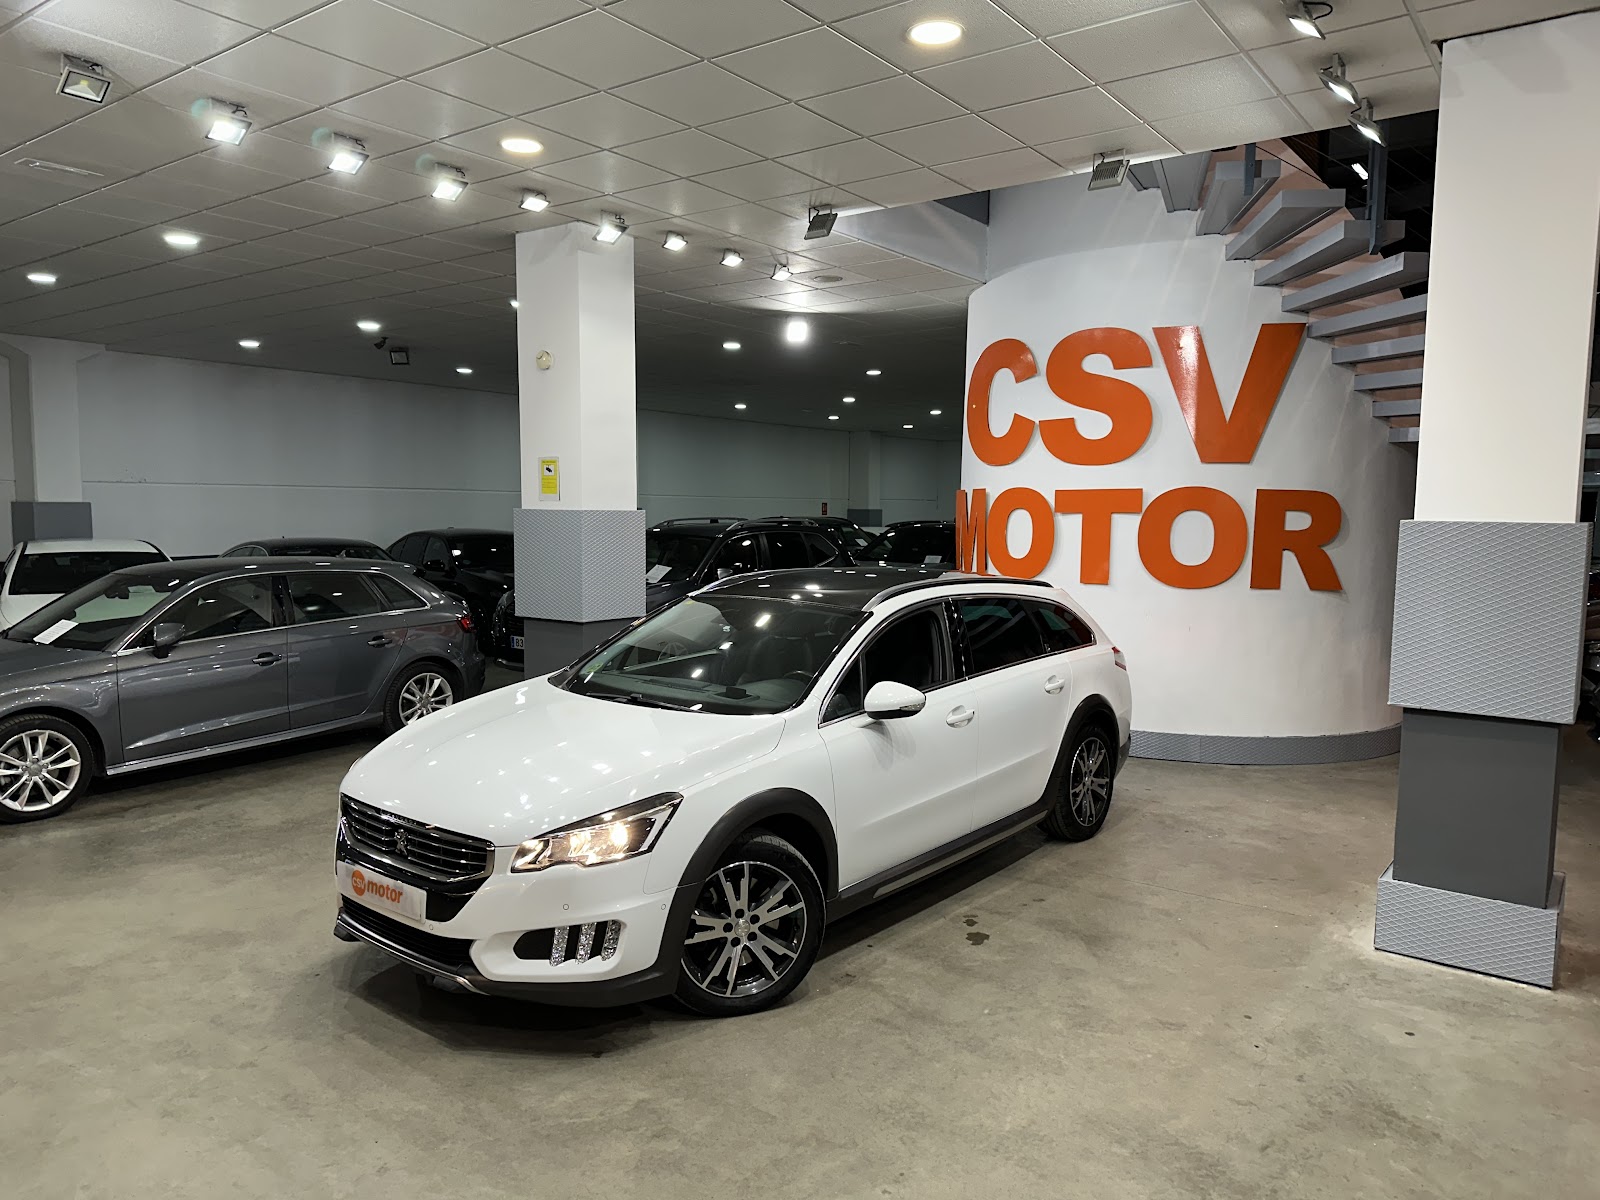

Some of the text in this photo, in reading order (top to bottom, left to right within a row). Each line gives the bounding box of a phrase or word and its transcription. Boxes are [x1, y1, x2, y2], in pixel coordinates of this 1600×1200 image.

[967, 323, 1306, 466] CSV
[956, 486, 1343, 590] MOTOR
[367, 880, 403, 903] motor
